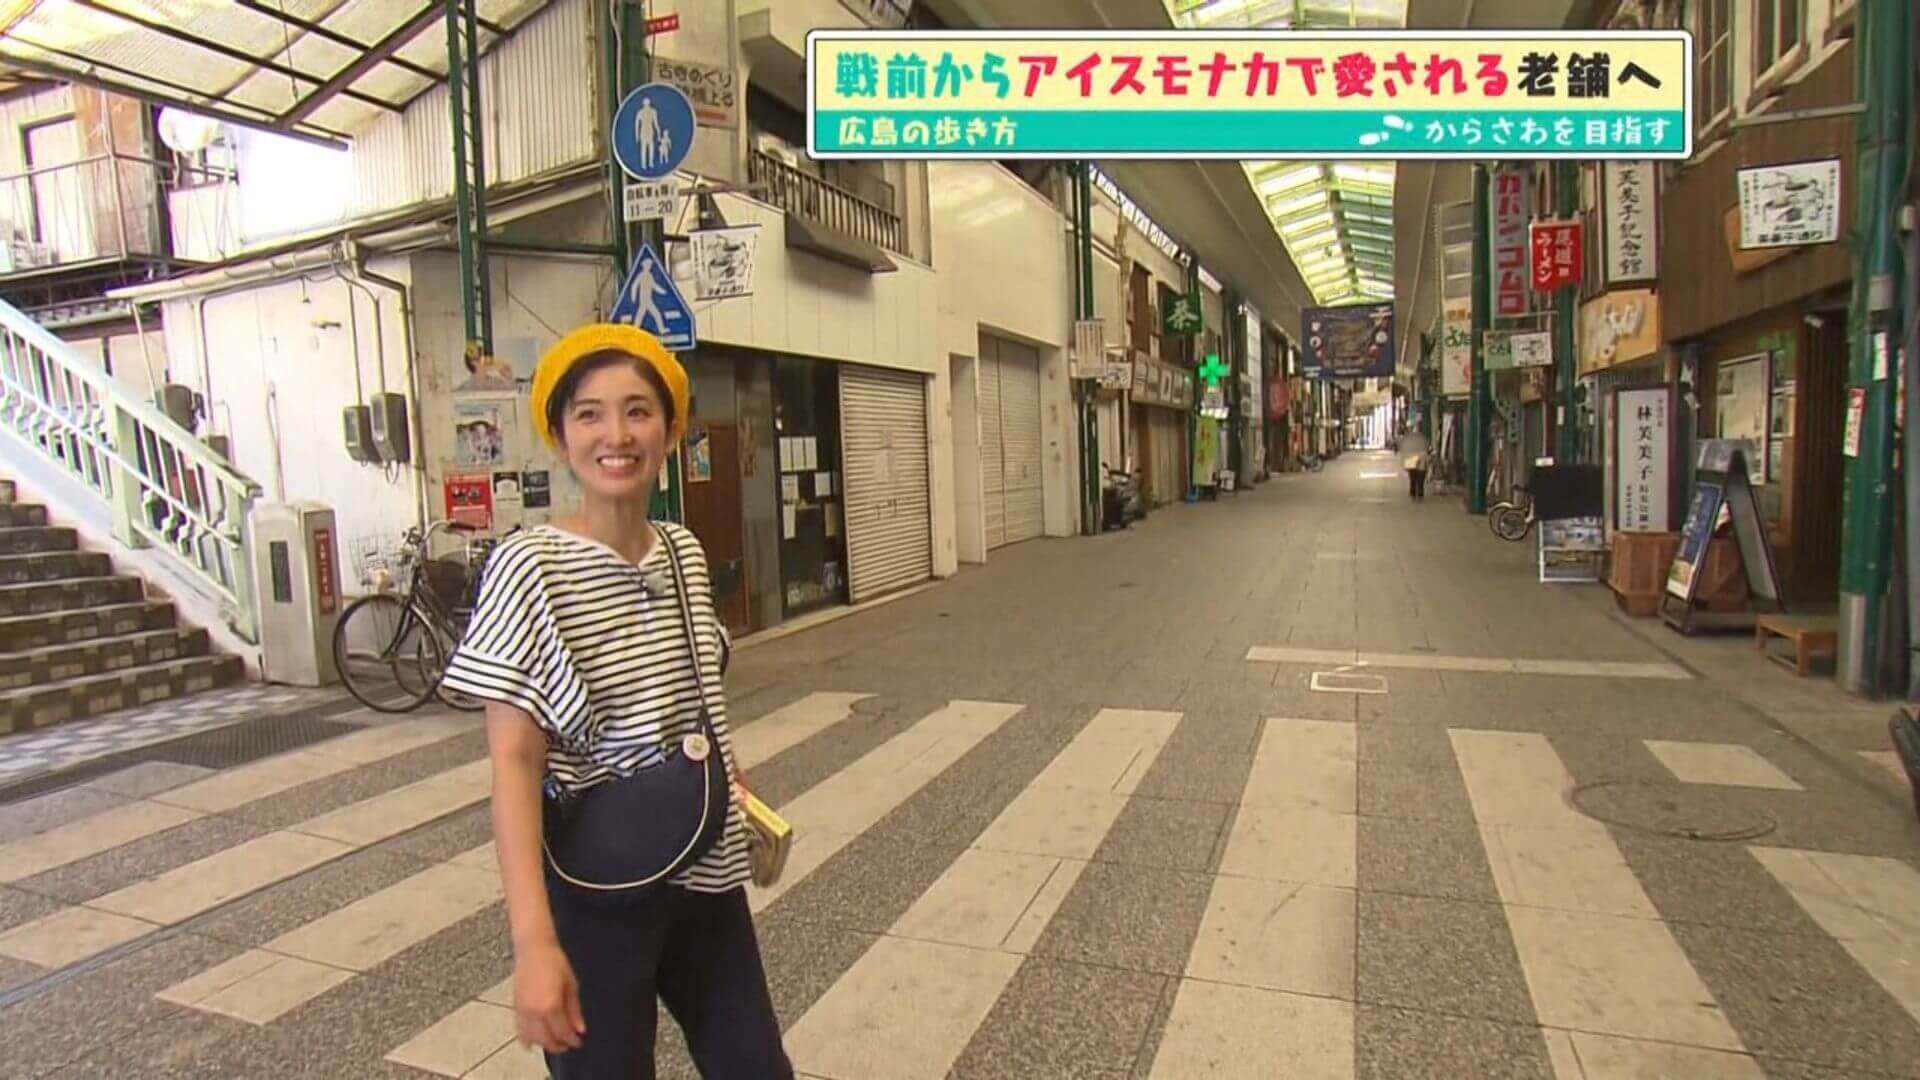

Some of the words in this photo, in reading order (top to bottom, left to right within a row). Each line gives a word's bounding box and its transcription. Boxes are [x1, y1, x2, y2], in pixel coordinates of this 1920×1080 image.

[1536, 230, 1553, 284] ラーメン
[1616, 160, 1643, 276] 芙美子記念館
